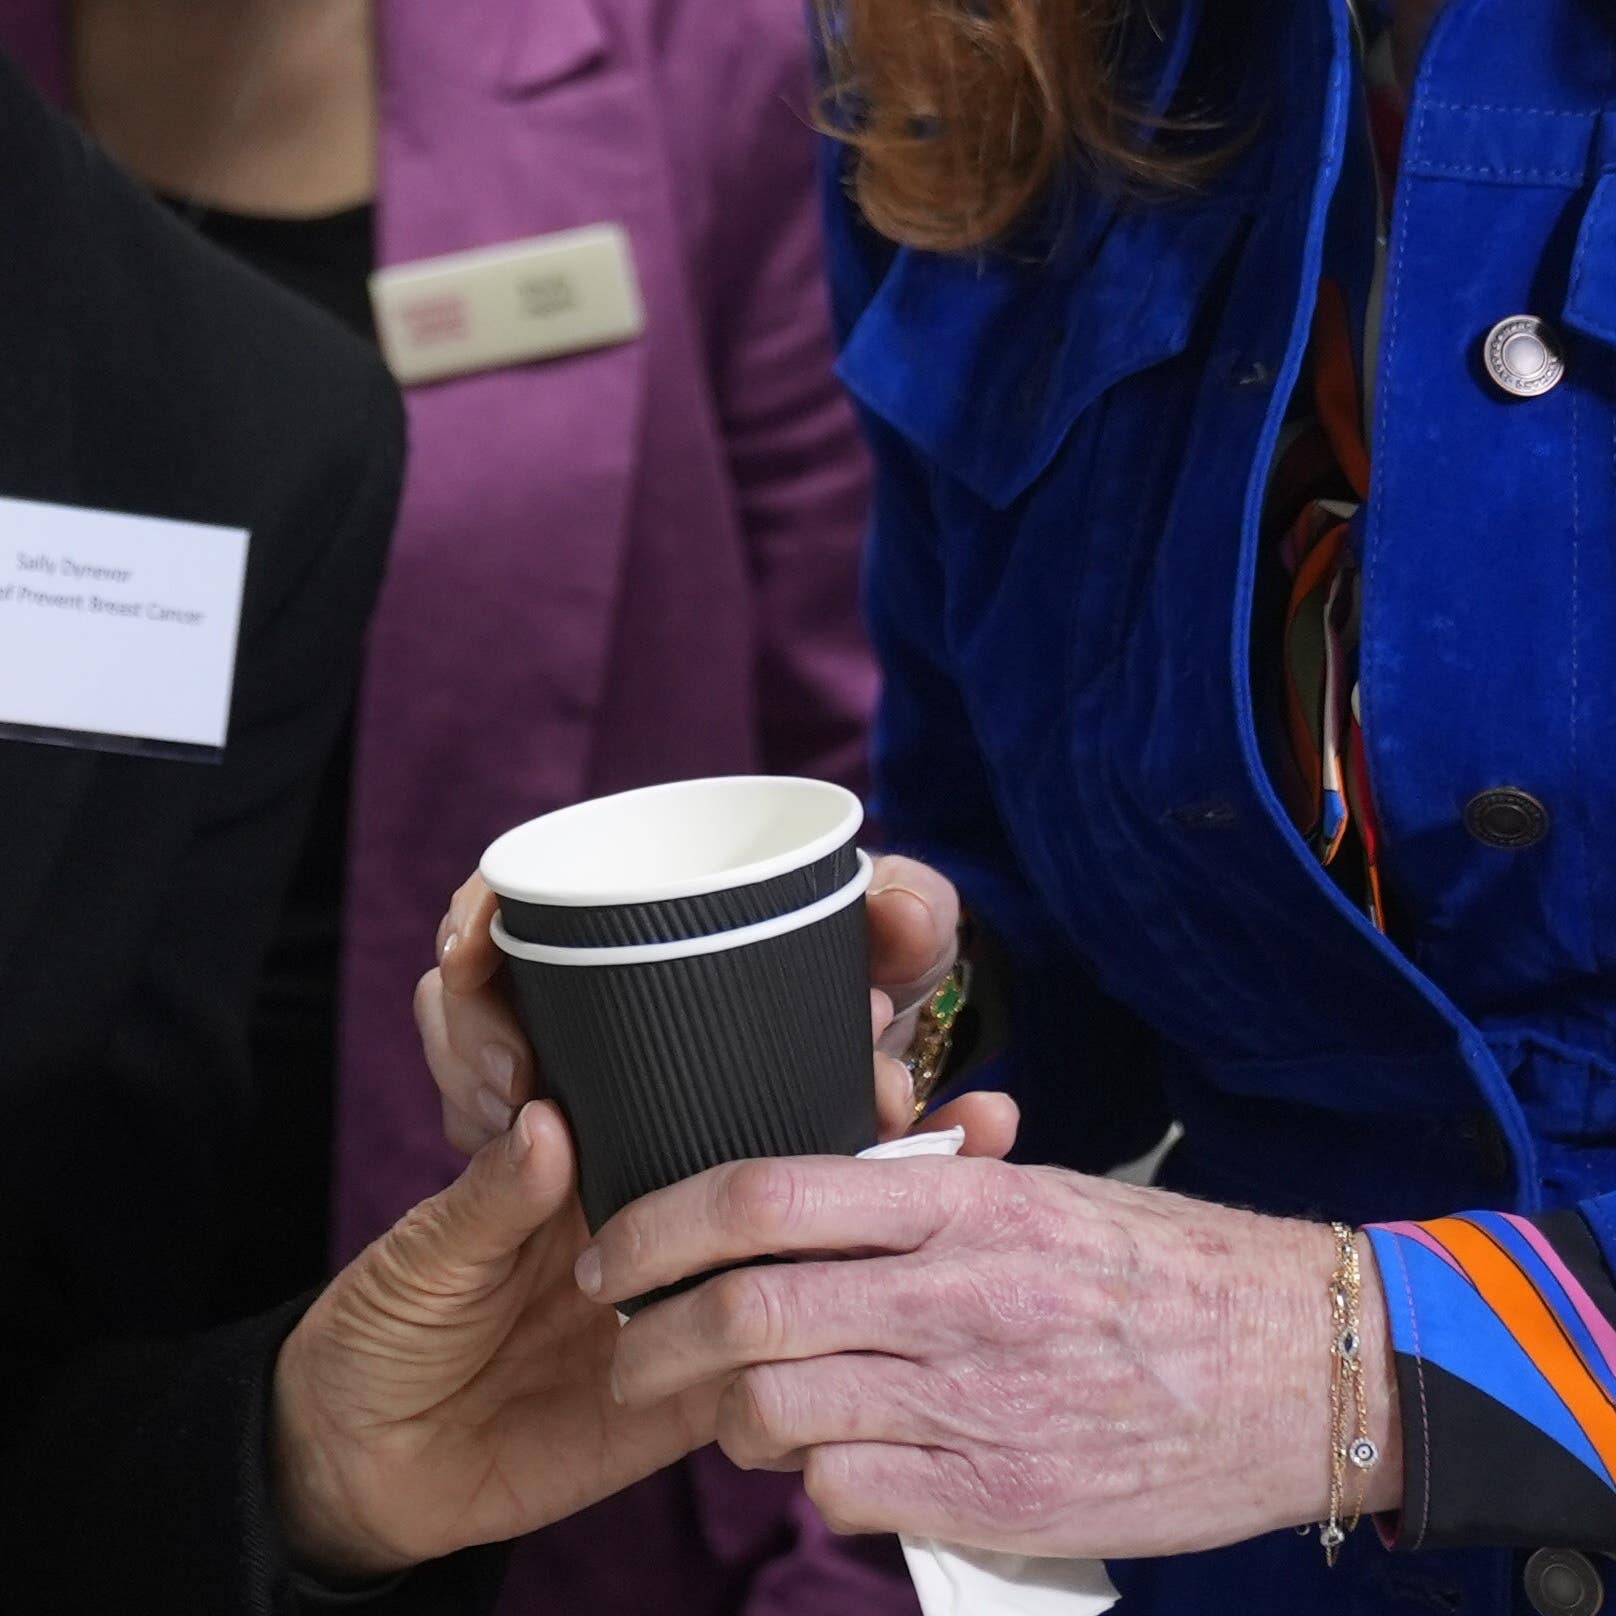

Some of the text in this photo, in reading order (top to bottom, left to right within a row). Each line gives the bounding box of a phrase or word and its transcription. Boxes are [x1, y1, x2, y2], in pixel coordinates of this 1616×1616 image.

[16, 551, 131, 582] Sally Dynevor
[17, 585, 83, 610] Prevent
[88, 594, 142, 617] Breast
[145, 601, 204, 624] Cancer
